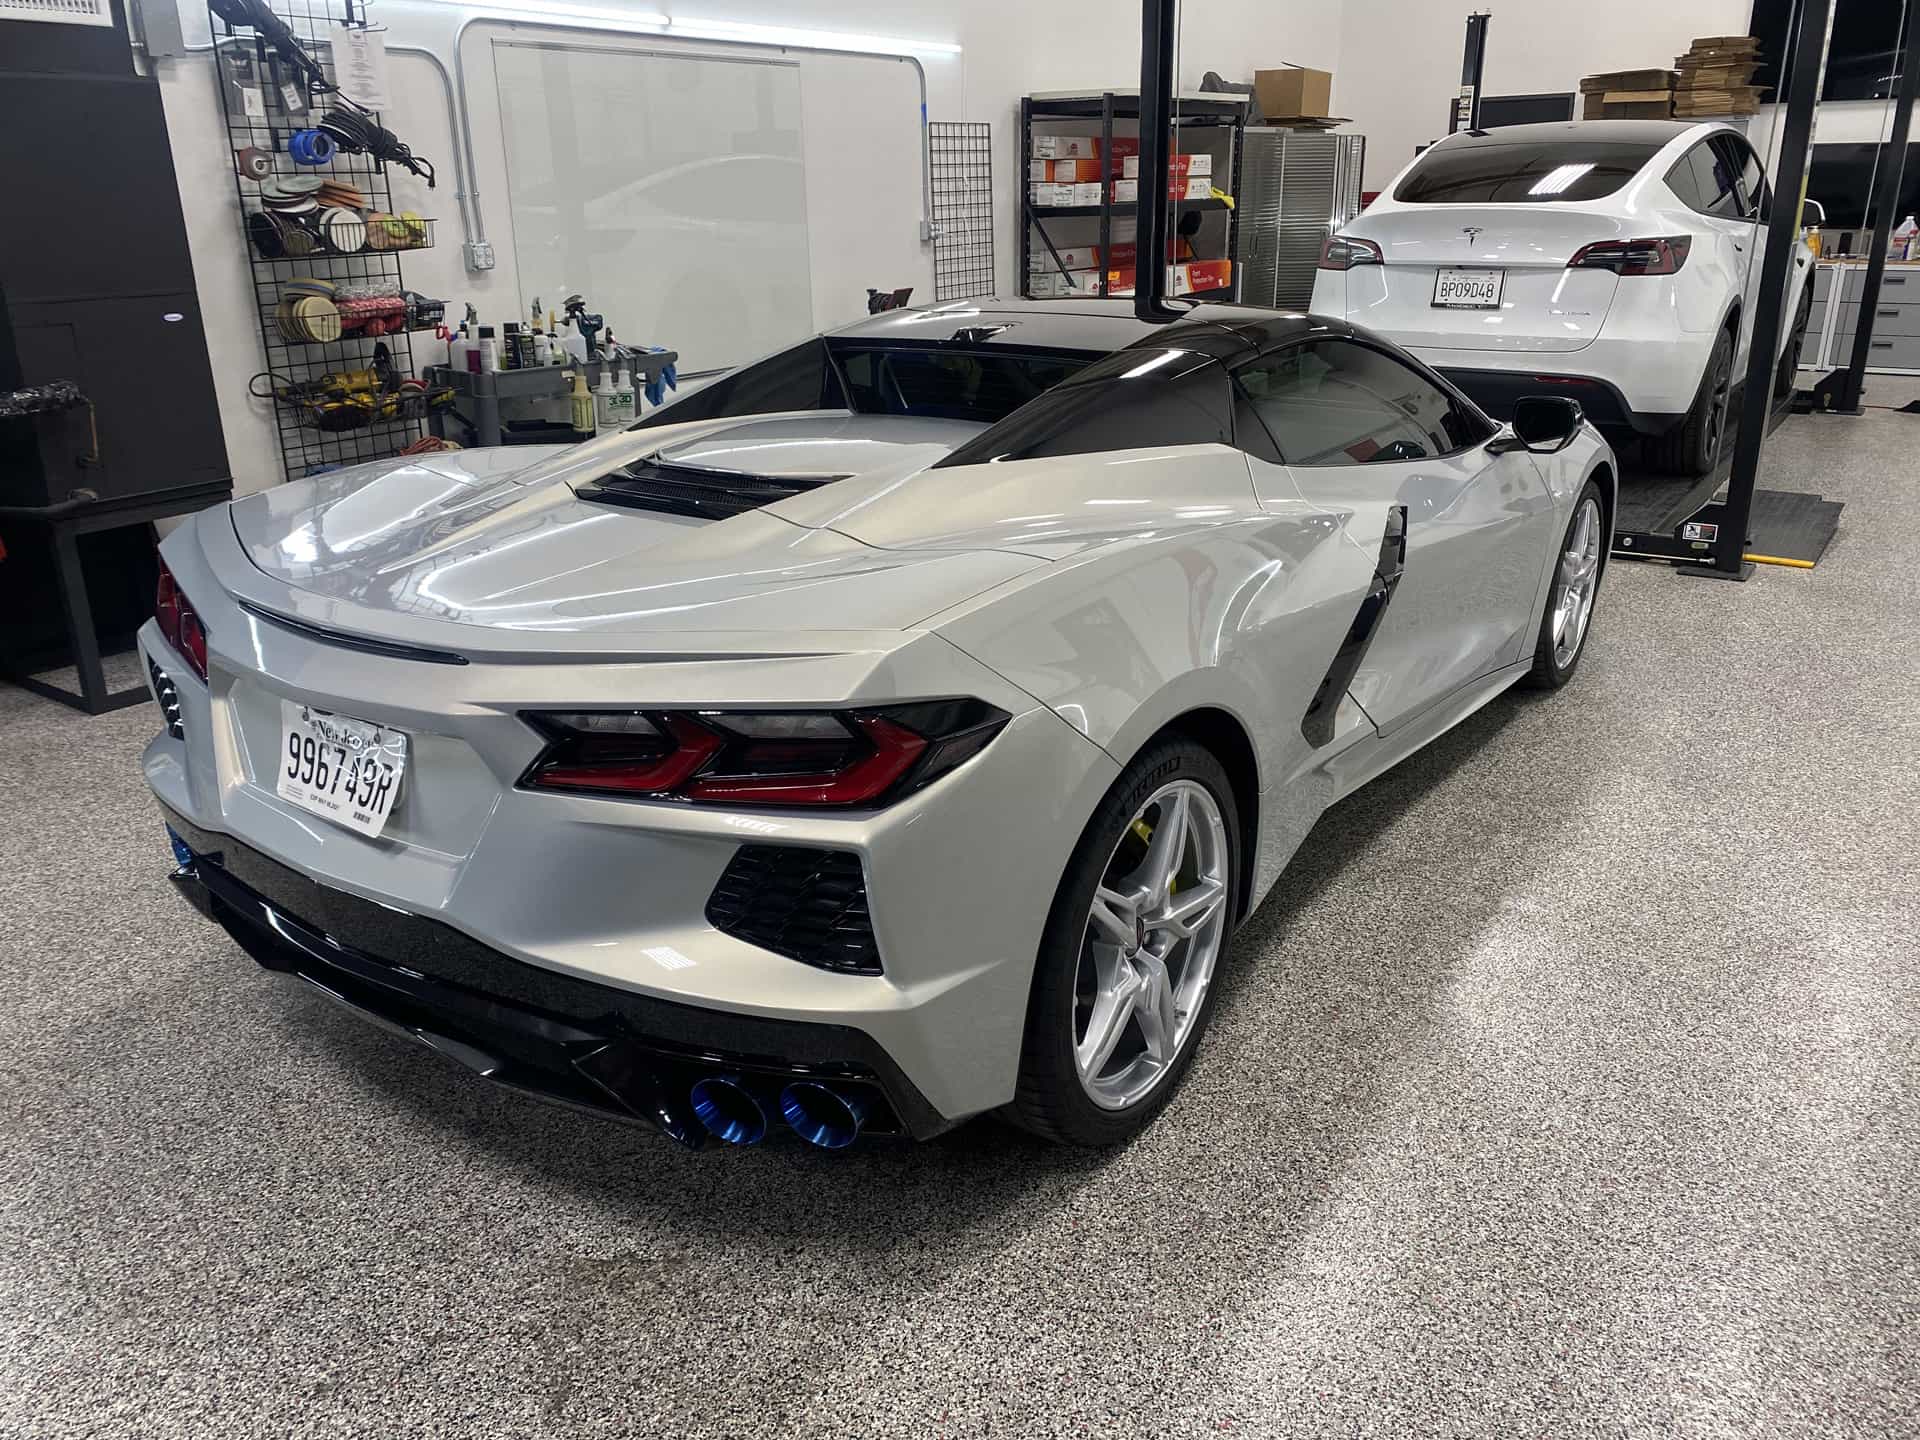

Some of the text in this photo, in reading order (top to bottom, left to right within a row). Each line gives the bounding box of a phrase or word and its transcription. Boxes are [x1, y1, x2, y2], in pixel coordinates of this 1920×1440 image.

[1440, 282, 1495, 298] BP09D48
[618, 394, 632, 404] 3D
[288, 732, 393, 815] 996749R
